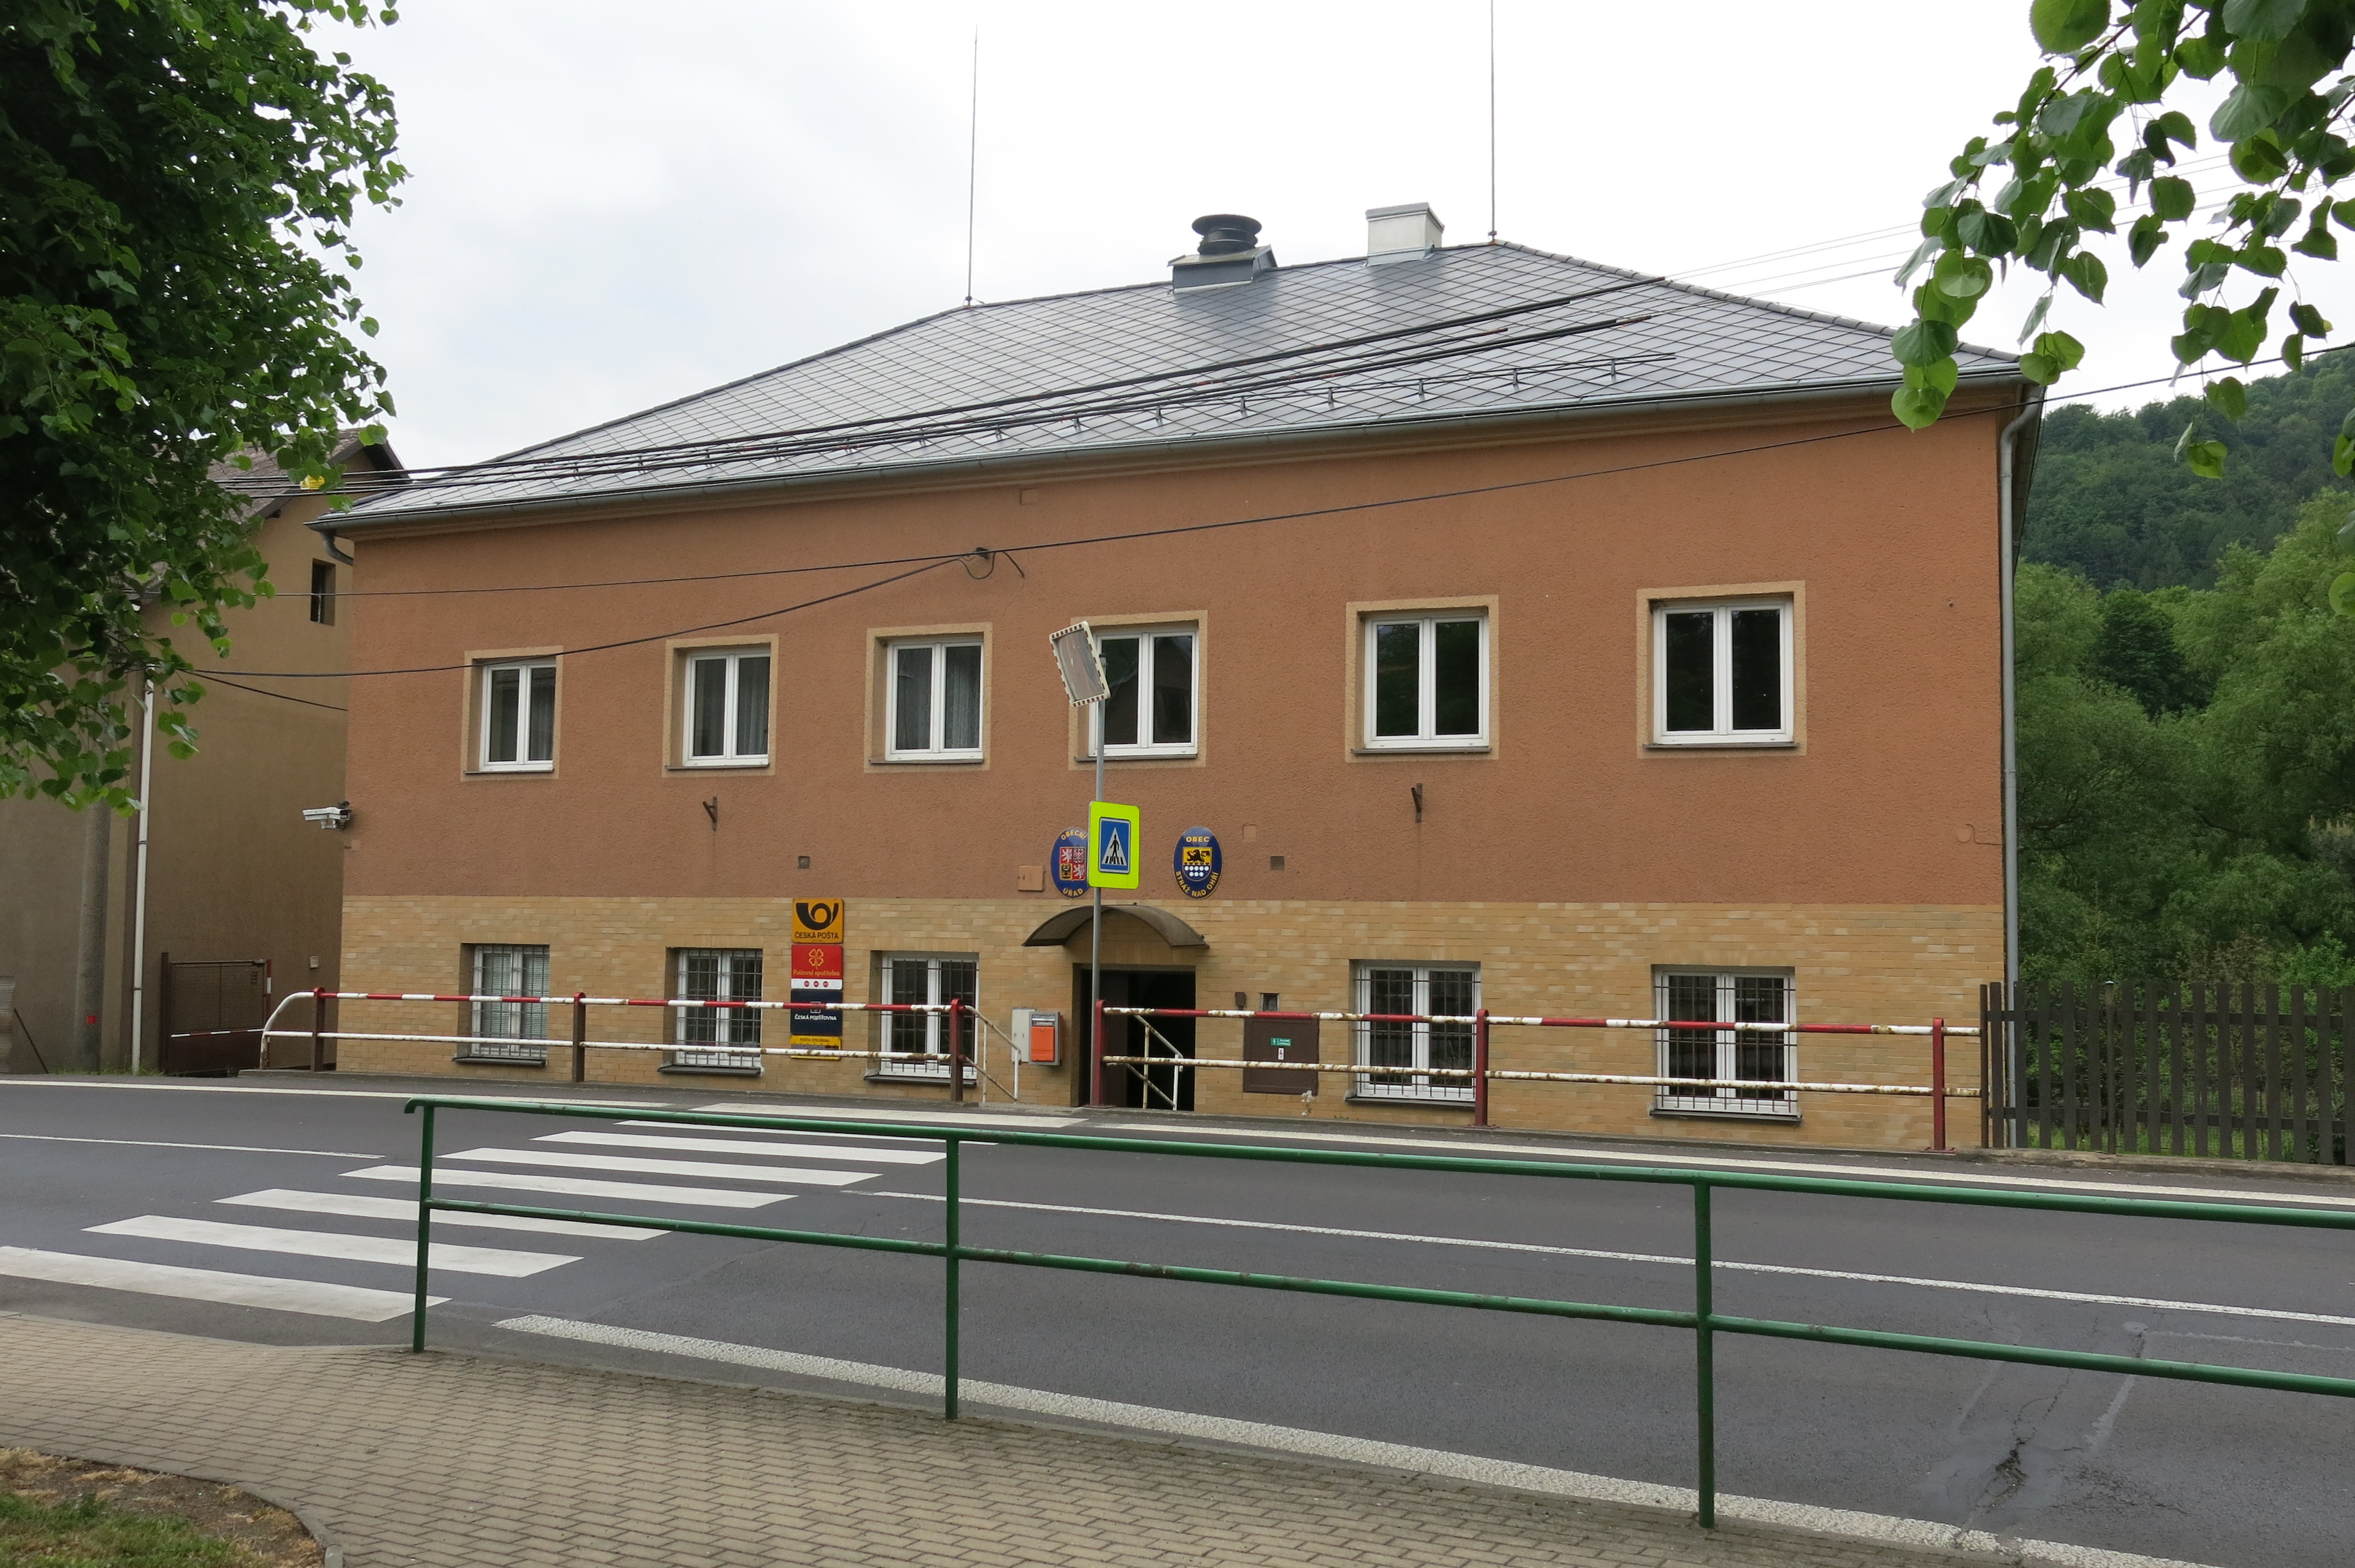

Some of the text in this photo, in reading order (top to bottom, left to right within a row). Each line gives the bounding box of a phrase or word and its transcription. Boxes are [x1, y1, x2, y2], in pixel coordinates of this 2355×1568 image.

[1061, 830, 1086, 840] OBECNÍ
[1176, 871, 1219, 897] STRÁŽ NAD OHŘÍ
[1063, 887, 1083, 896] ÚŘAD
